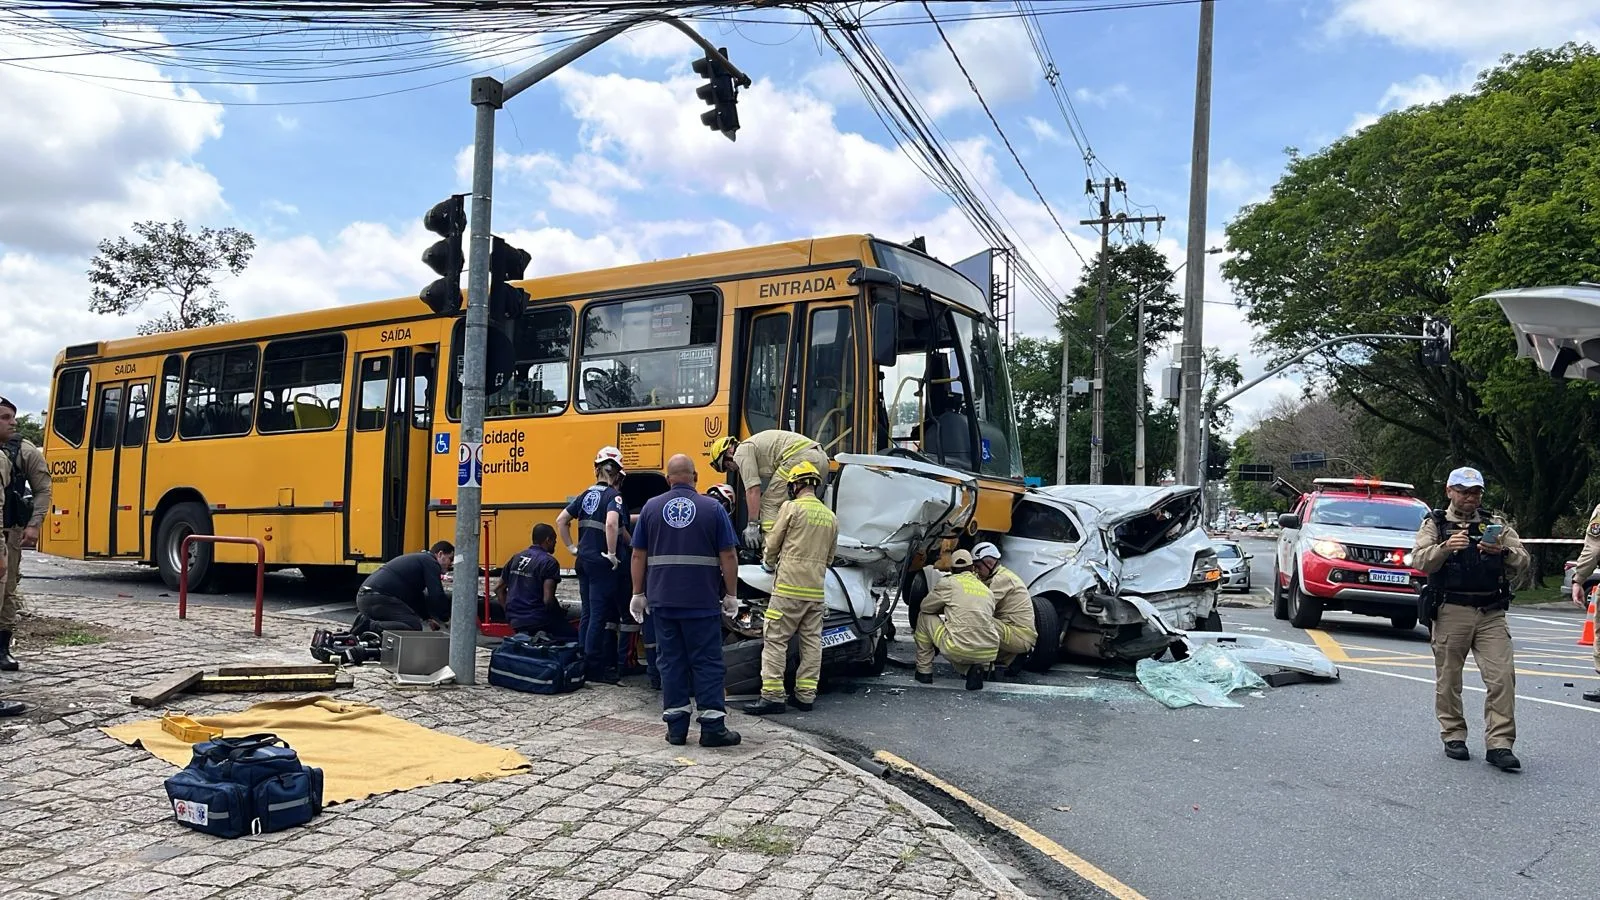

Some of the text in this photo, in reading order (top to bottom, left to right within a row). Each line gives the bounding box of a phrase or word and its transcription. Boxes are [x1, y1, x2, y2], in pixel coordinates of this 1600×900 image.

[760, 277, 836, 299] ENTRADA
[381, 327, 412, 343] SAÍDA
[115, 363, 136, 375] SAÍDA
[485, 429, 525, 444] cidade
[509, 445, 525, 458] de
[483, 459, 529, 474] curitiba
